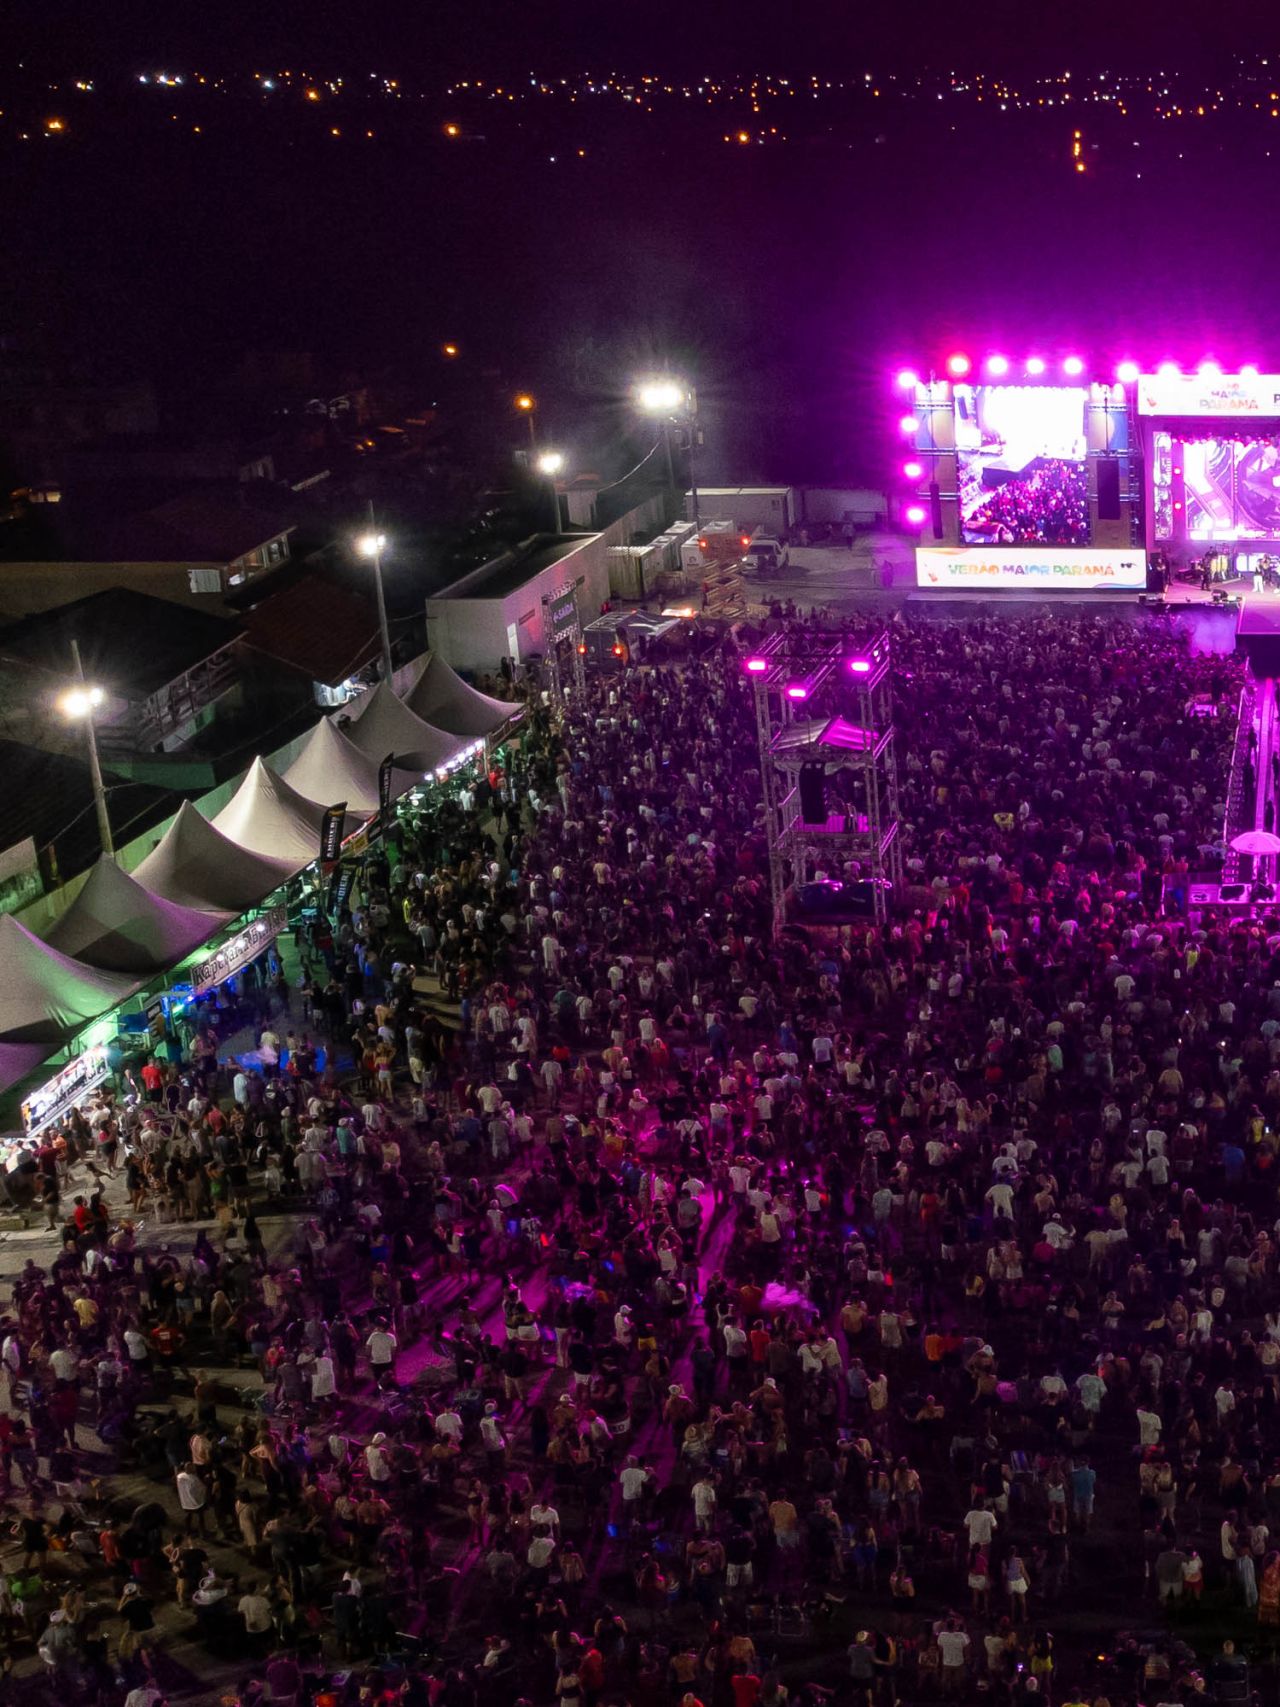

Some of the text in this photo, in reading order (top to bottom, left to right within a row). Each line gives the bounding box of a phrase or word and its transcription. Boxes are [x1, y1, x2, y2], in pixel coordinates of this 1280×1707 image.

[948, 562, 1115, 576] VERÃO MAIOR PARANÁ
